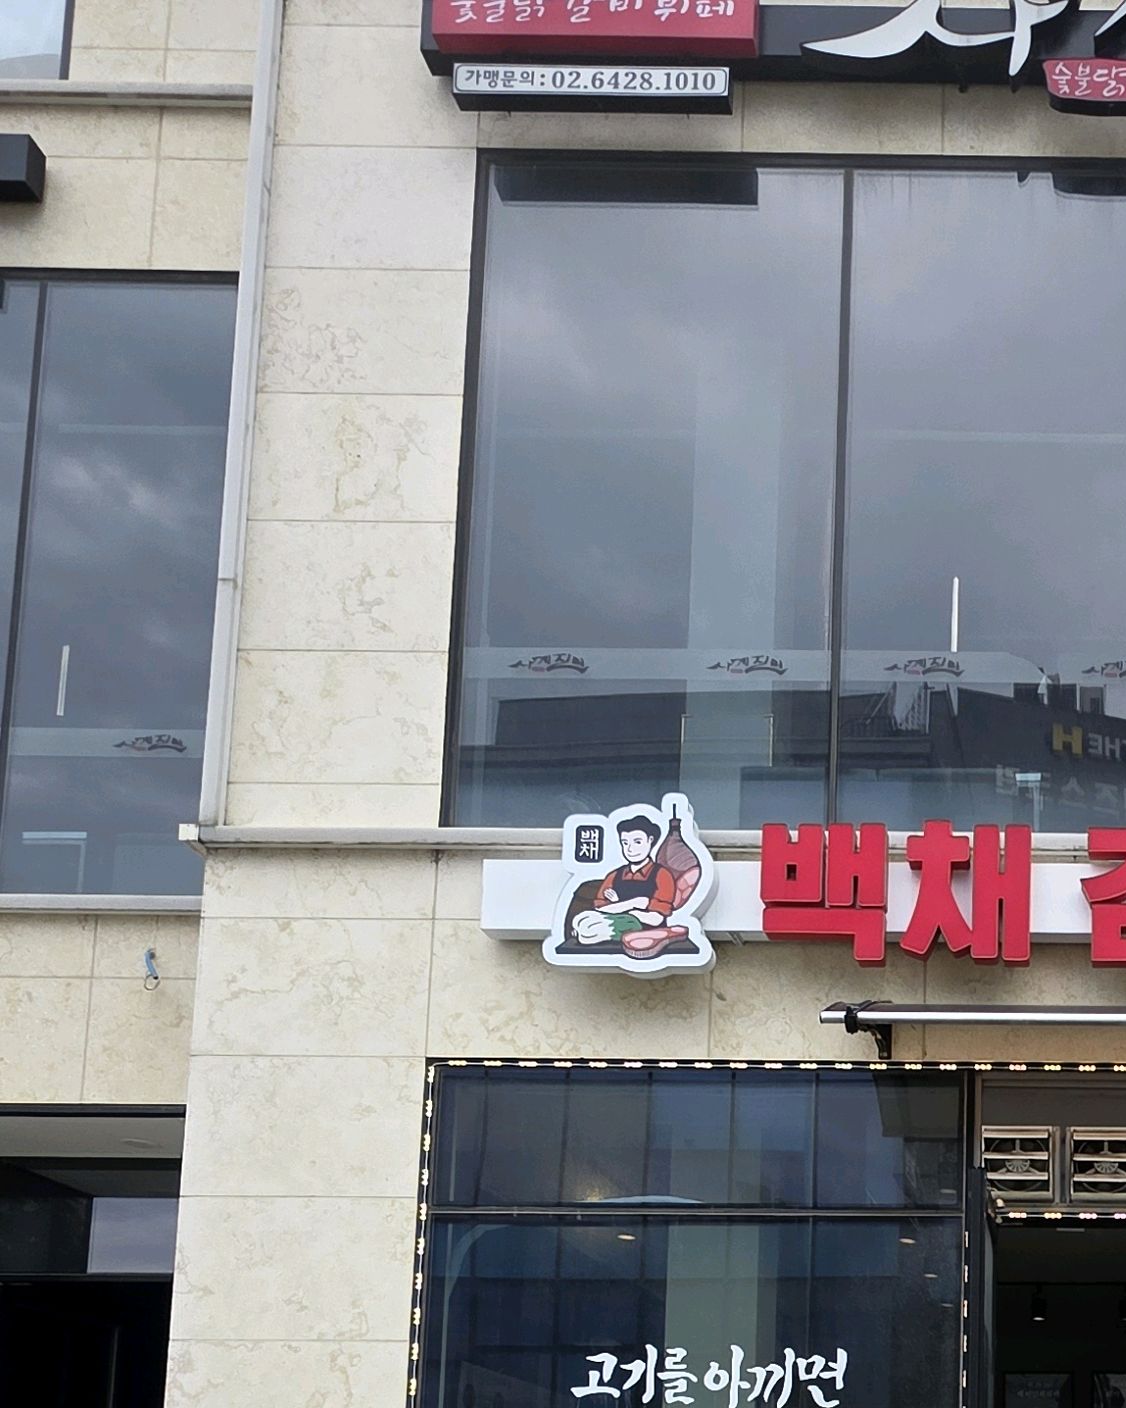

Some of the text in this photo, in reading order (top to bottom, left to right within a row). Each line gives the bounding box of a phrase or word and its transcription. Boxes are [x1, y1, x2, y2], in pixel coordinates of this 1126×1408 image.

[551, 71, 716, 91] 02.6428.1010
[579, 828, 600, 860] 백채
[760, 818, 1032, 968] 백채
[570, 1344, 699, 1405] 고기를
